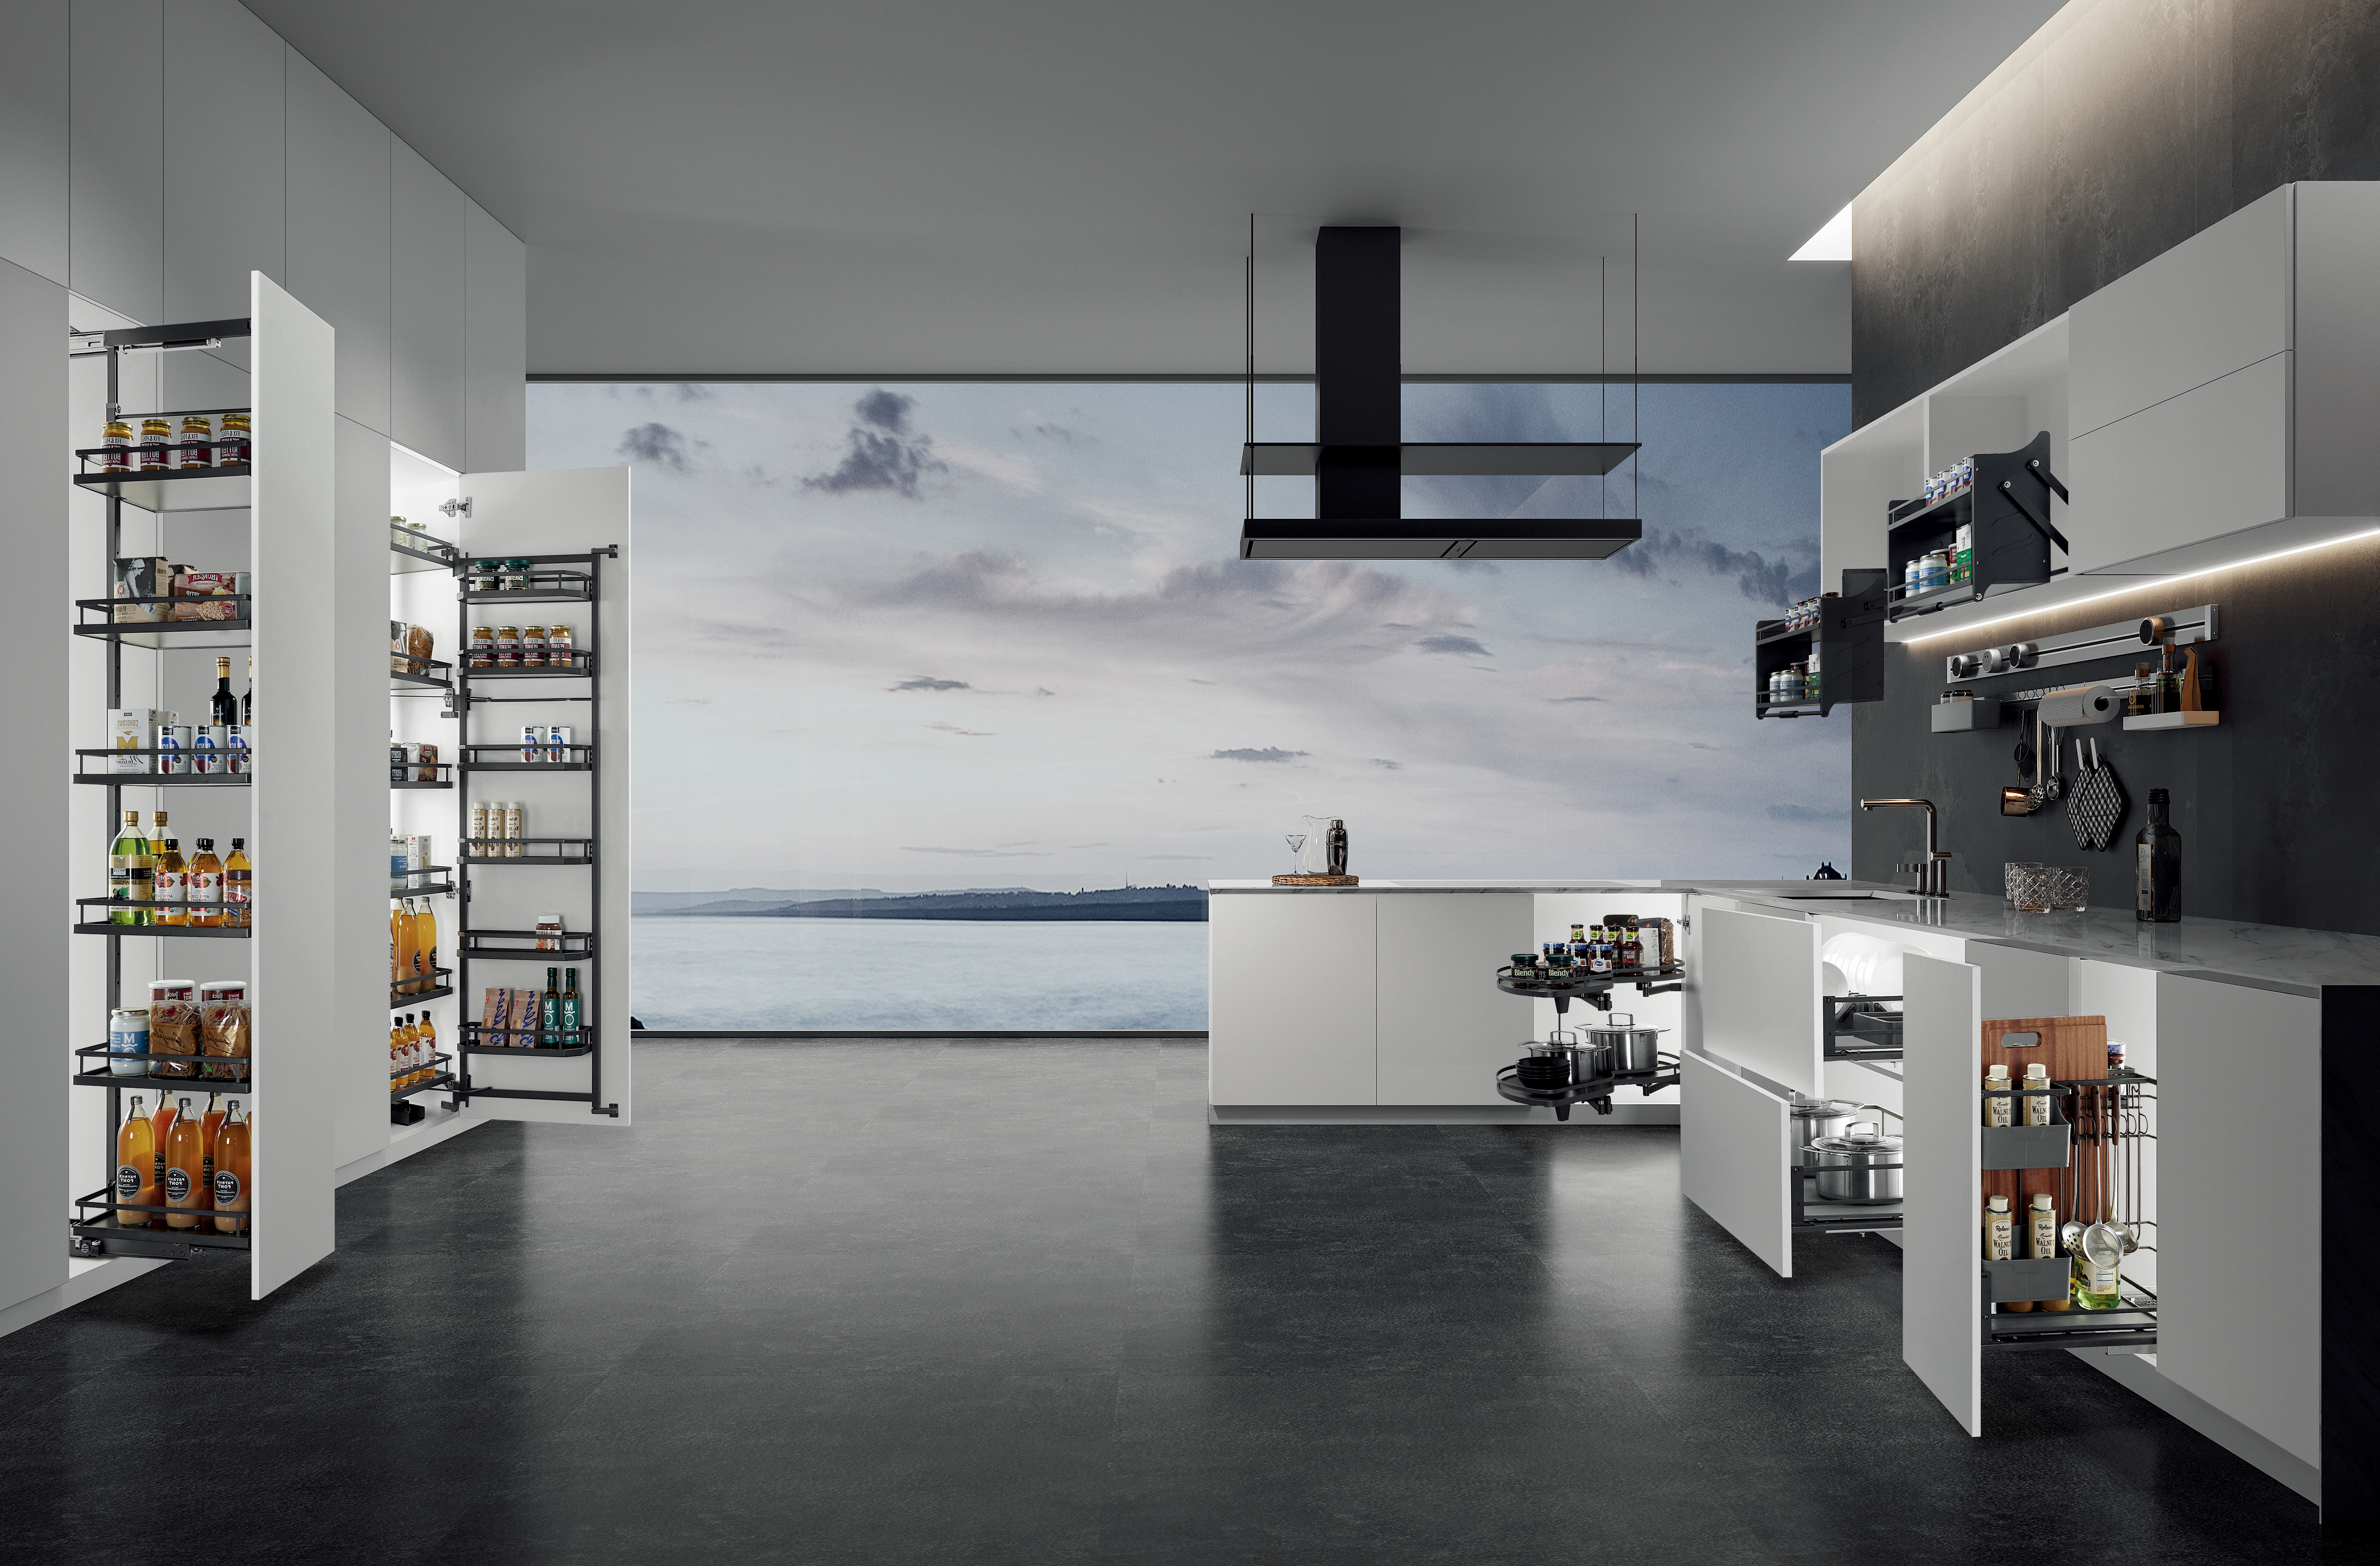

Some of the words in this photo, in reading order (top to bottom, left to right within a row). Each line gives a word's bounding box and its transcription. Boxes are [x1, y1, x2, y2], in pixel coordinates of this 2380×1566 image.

[1993, 1107, 2011, 1115] WALNUT
[1993, 1239, 2011, 1248] WALNUT
[2036, 1237, 2055, 1247] WALNUT
[1999, 1248, 2009, 1256] OIL
